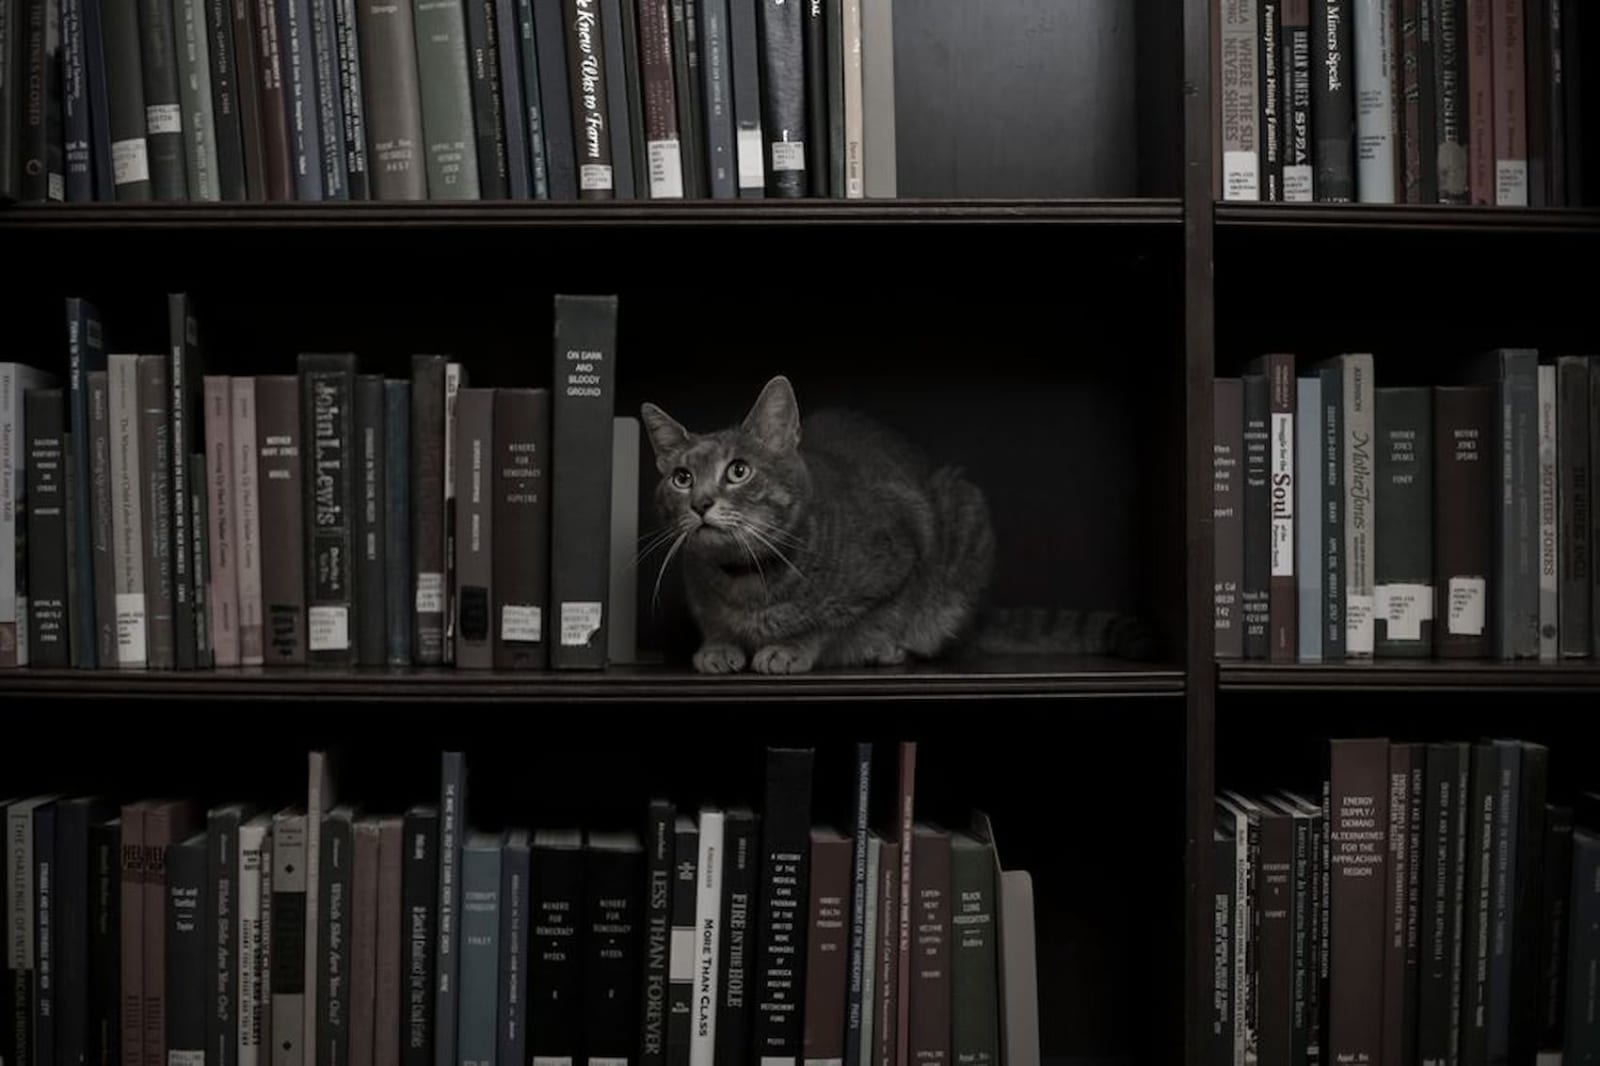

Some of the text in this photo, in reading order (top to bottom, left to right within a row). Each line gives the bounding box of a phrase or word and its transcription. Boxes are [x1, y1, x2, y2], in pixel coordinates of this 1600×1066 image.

[575, 10, 594, 53] Knew
[1326, 6, 1342, 91] Miners Speak
[581, 55, 599, 92] Was
[1239, 38, 1253, 88] WHERE
[583, 95, 597, 109] to
[1224, 38, 1238, 141] NEVER SHINES
[1264, 5, 1277, 162] Pennsylvania Mining Families
[1294, 31, 1309, 164] HARLAN MINERS SPEA
[1240, 94, 1253, 122] THE
[585, 113, 603, 158] Farm
[566, 350, 579, 360] ON
[575, 363, 593, 372] AND
[566, 386, 602, 396] GROUND
[568, 374, 600, 384] BLOODY
[315, 382, 341, 525] John L. Lewis
[1280, 460, 1288, 472] the
[1351, 430, 1371, 488] Mother
[1273, 473, 1292, 520] Soul
[1350, 486, 1371, 529] Jones
[1543, 464, 1554, 576] MOTHER JONES
[1340, 808, 1376, 817] SUPPLY/
[1343, 796, 1374, 806] ENERGY
[15, 824, 25, 844] THE
[1331, 831, 1385, 840] ALTERNATIVES
[1341, 819, 1376, 828] DEMAND
[1331, 855, 1384, 863] APPALACHIAN
[1341, 843, 1375, 852] FOR THE
[14, 849, 26, 914] CHALLENGE
[1343, 867, 1373, 876] REGION
[15, 918, 26, 930] OF
[645, 870, 668, 1055] LESS THAN FOREVER
[727, 894, 748, 1008] FIRE IN THE HOLE
[699, 919, 714, 1036] MORE THAN CLASS
